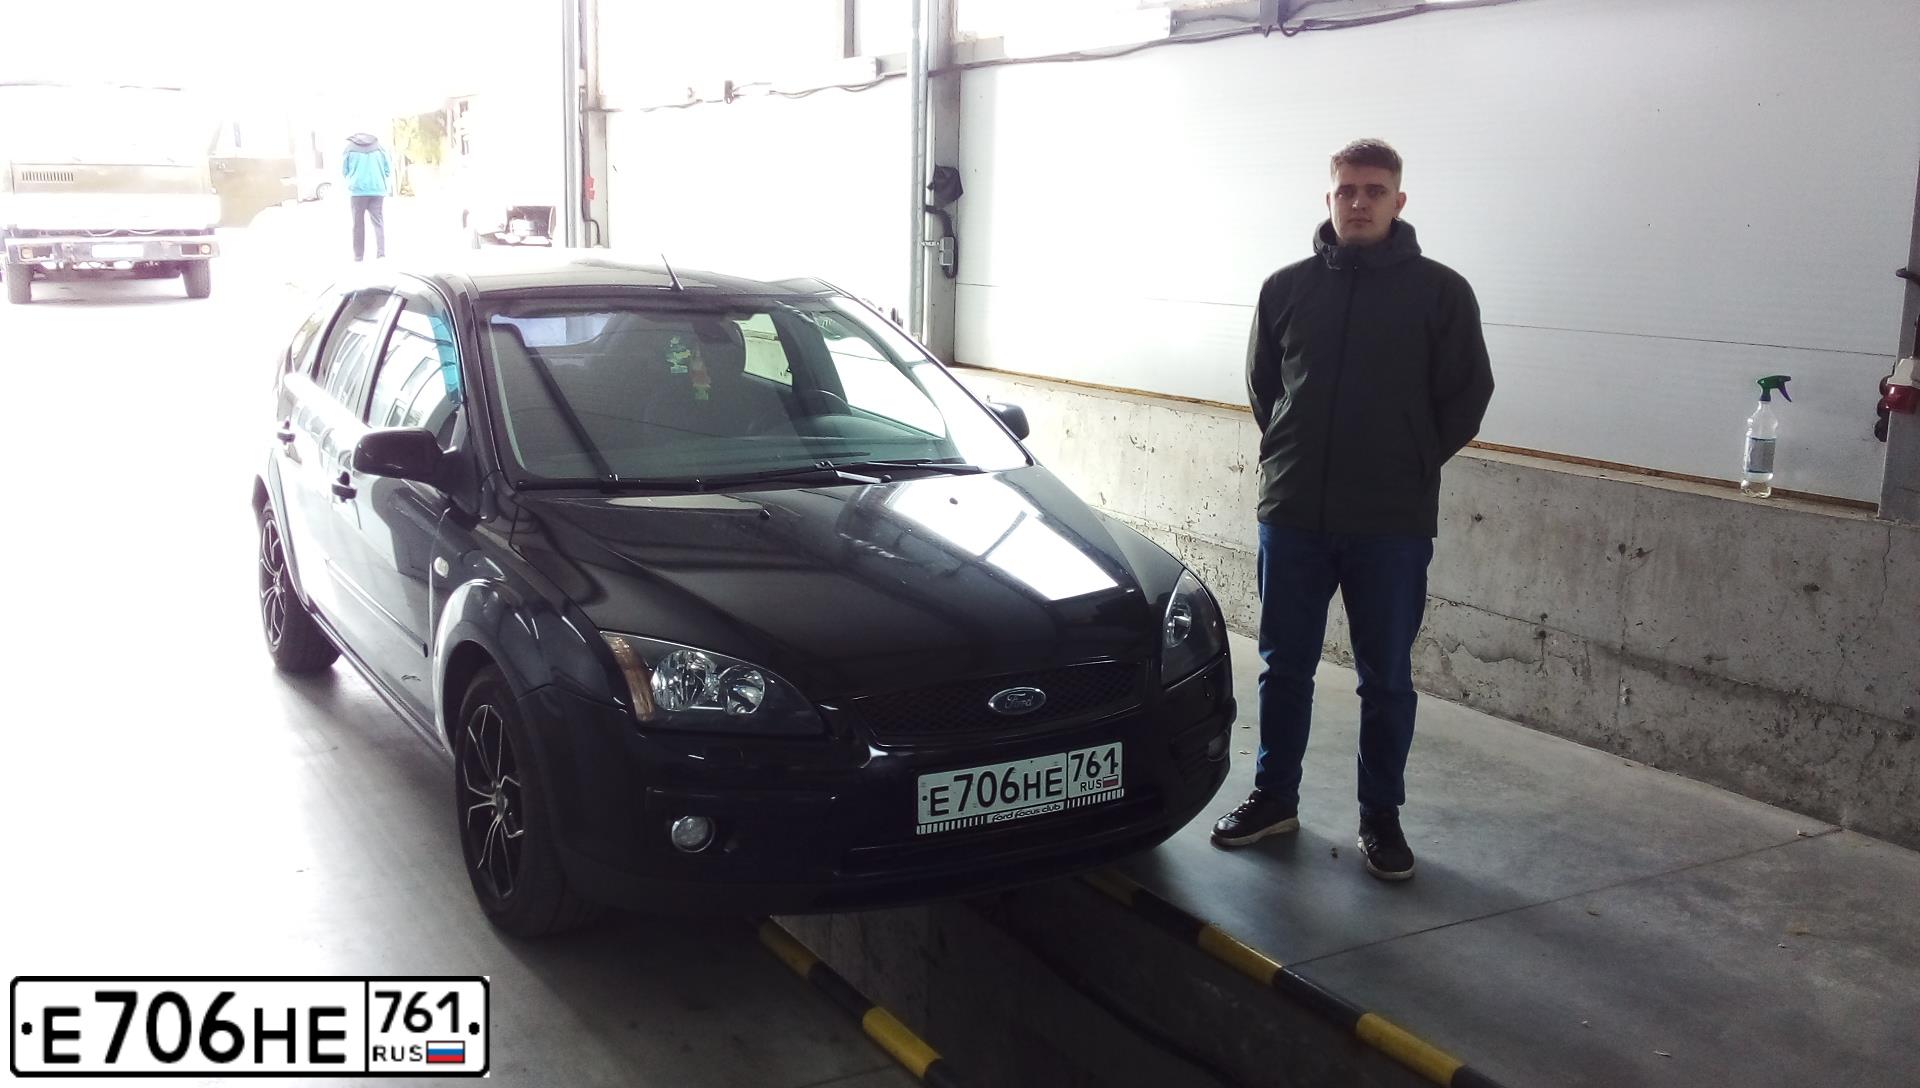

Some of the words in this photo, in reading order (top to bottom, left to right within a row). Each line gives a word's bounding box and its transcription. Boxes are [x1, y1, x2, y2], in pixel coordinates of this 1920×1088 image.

[929, 766, 1063, 817] E706HE
[1070, 747, 1117, 782] 761
[1080, 779, 1102, 792] RUS
[1015, 808, 1040, 819] focus
[1041, 803, 1061, 813] club
